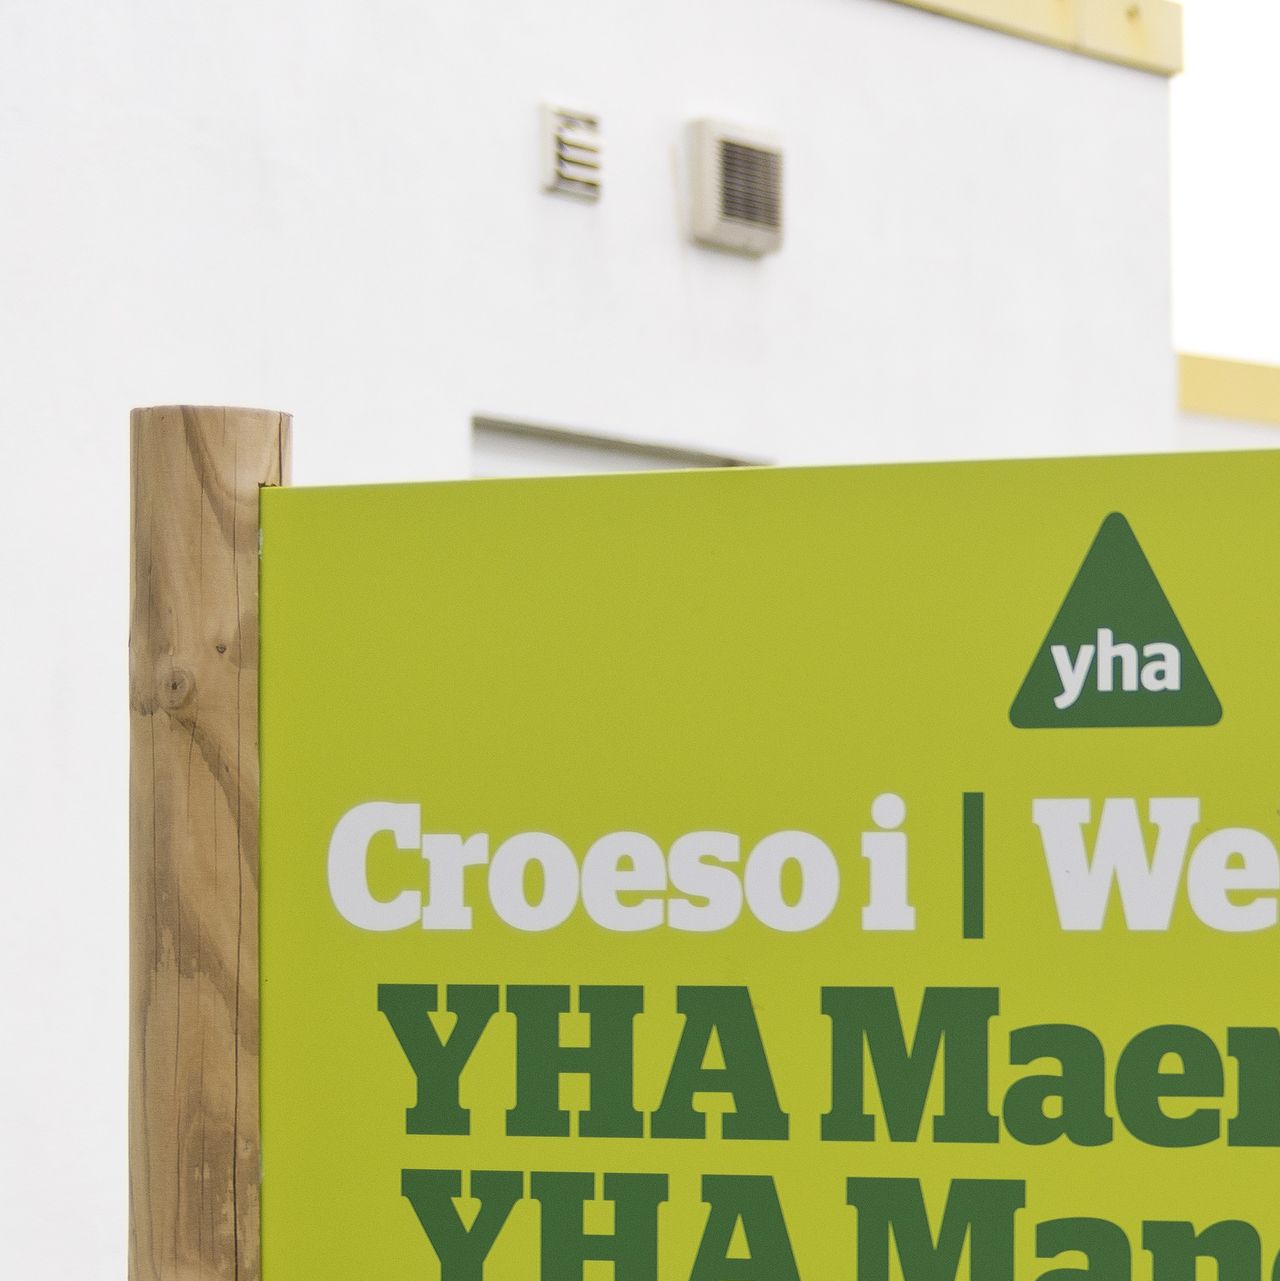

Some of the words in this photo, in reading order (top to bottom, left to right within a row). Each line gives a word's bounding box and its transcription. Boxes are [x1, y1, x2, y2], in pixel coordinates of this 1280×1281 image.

[1050, 628, 1181, 709] yha
[325, 800, 841, 933] Croeso
[860, 792, 917, 932] i
[376, 983, 791, 1141] YHA
